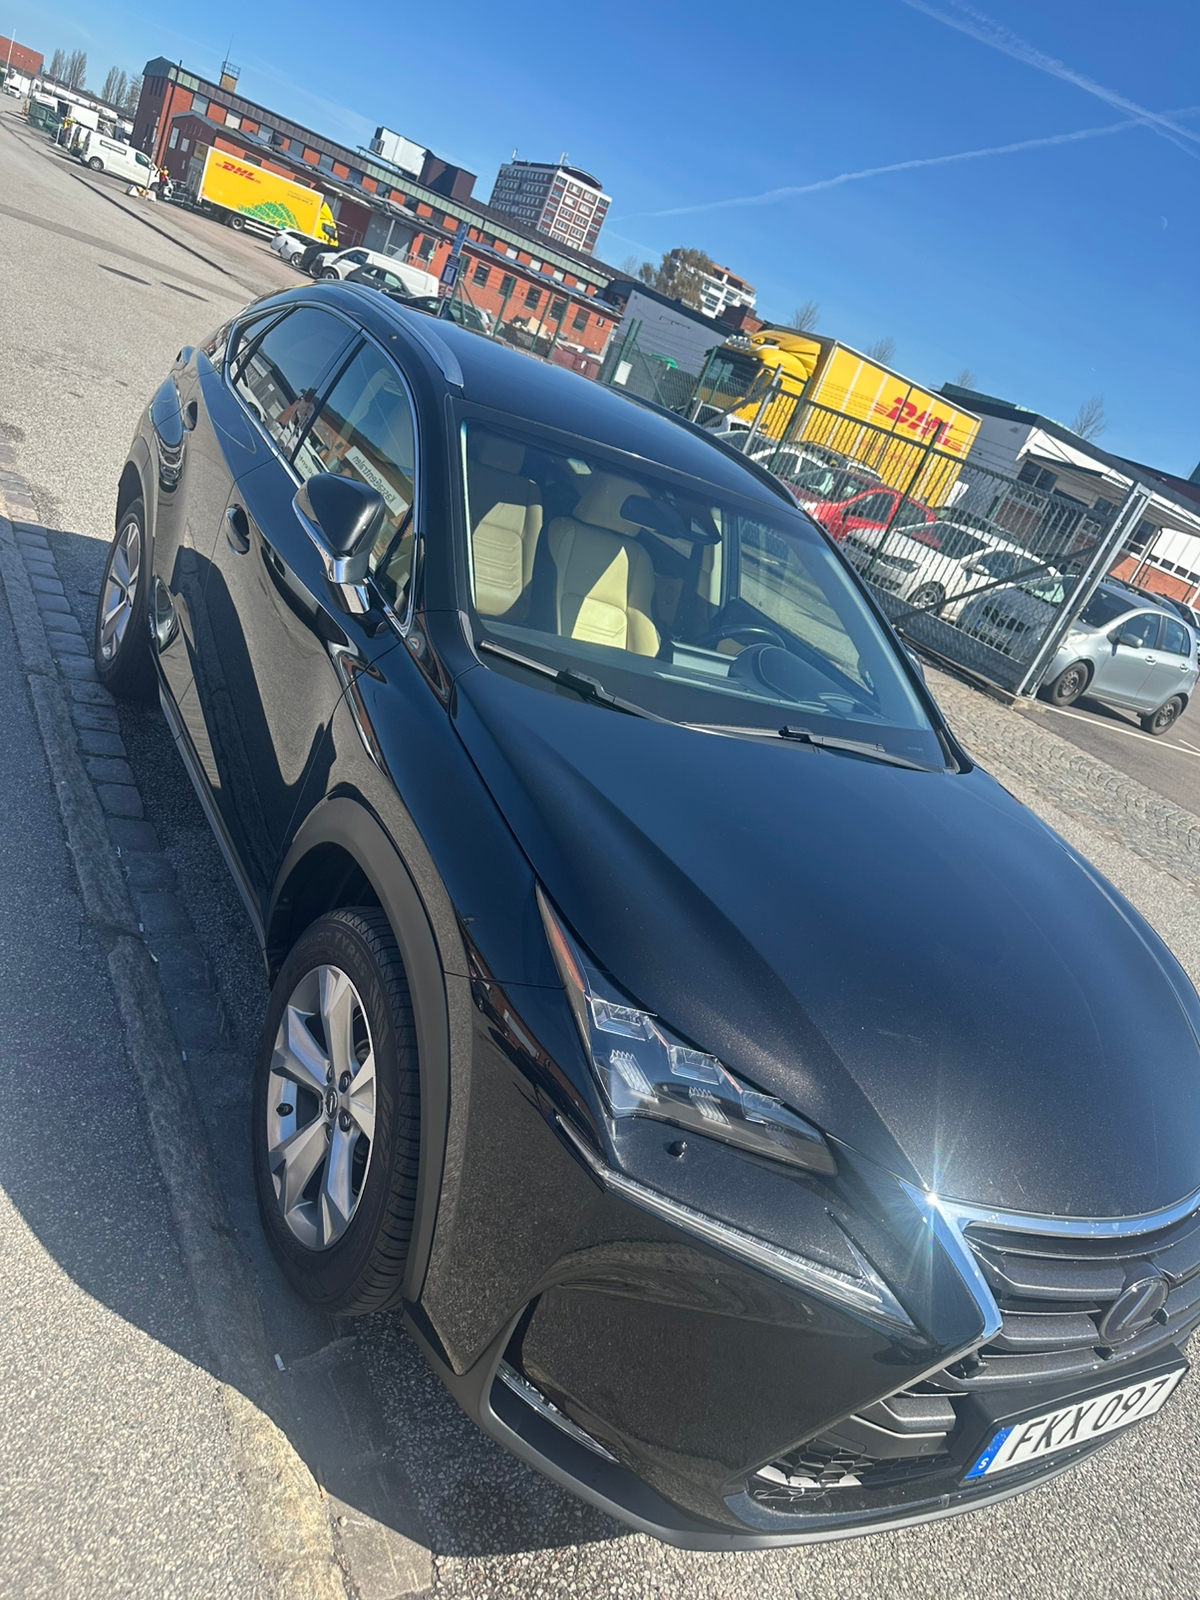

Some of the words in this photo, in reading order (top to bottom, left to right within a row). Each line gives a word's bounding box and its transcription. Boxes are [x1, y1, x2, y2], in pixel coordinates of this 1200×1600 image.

[222, 161, 255, 181] DHL
[335, 932, 368, 977] TYRES
[1006, 1402, 1096, 1461] FKX
[1093, 1376, 1171, 1431] 097
[978, 1457, 990, 1469] S
